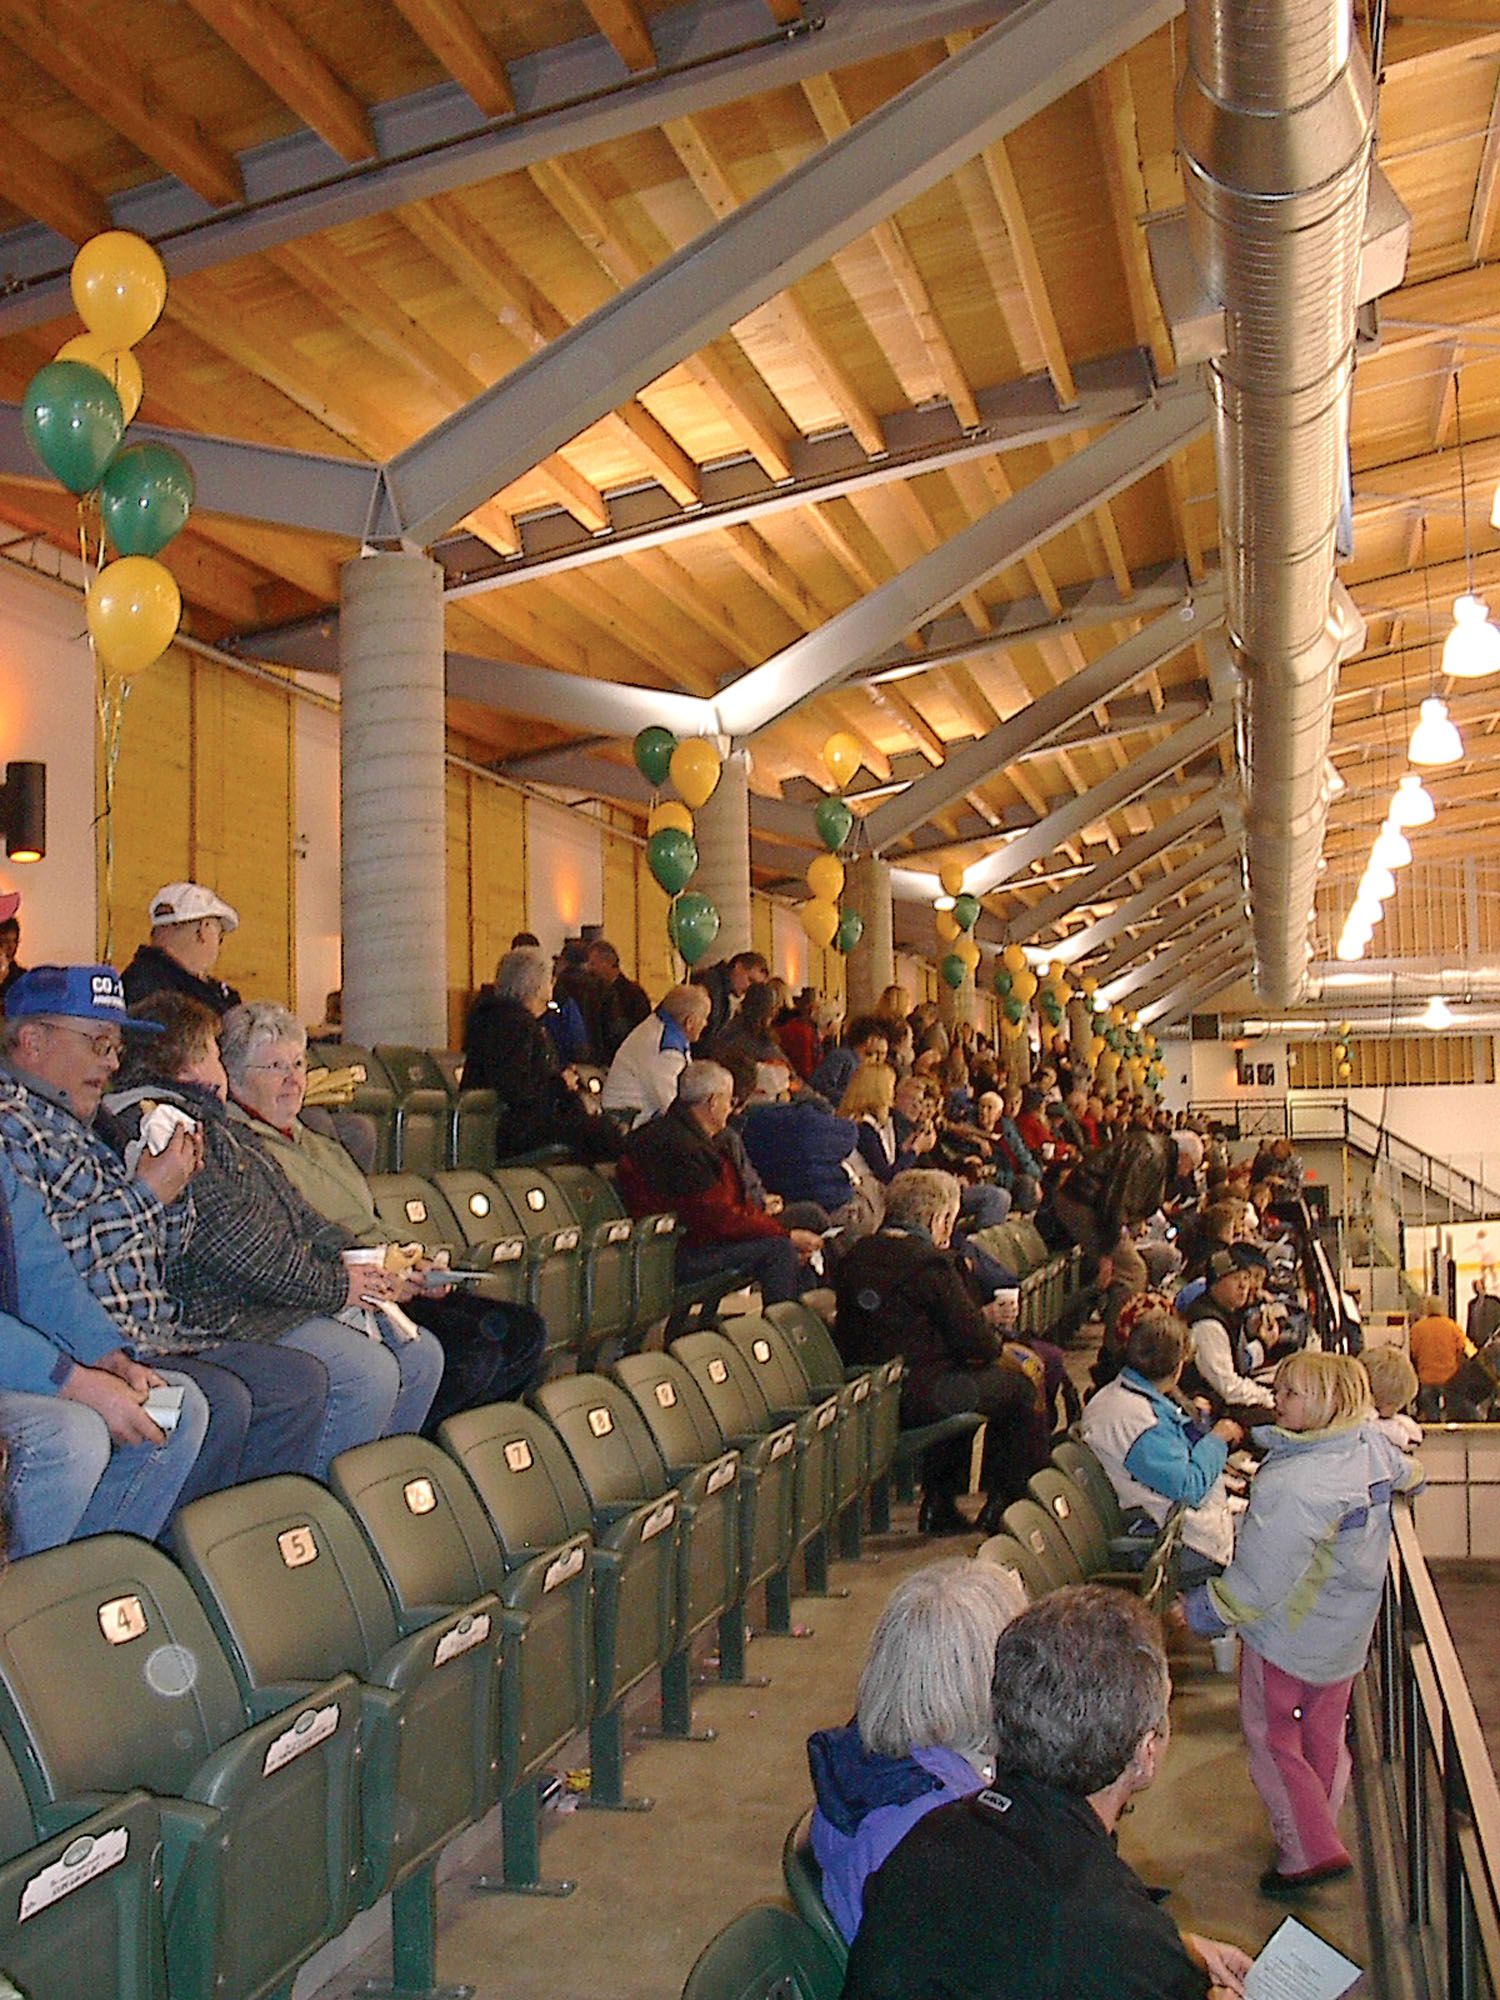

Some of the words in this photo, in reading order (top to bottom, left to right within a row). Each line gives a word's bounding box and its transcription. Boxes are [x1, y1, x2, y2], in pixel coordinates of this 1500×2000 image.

[512, 1446, 522, 1465] 7
[291, 1534, 306, 1560] 5
[117, 1606, 132, 1632] 4
